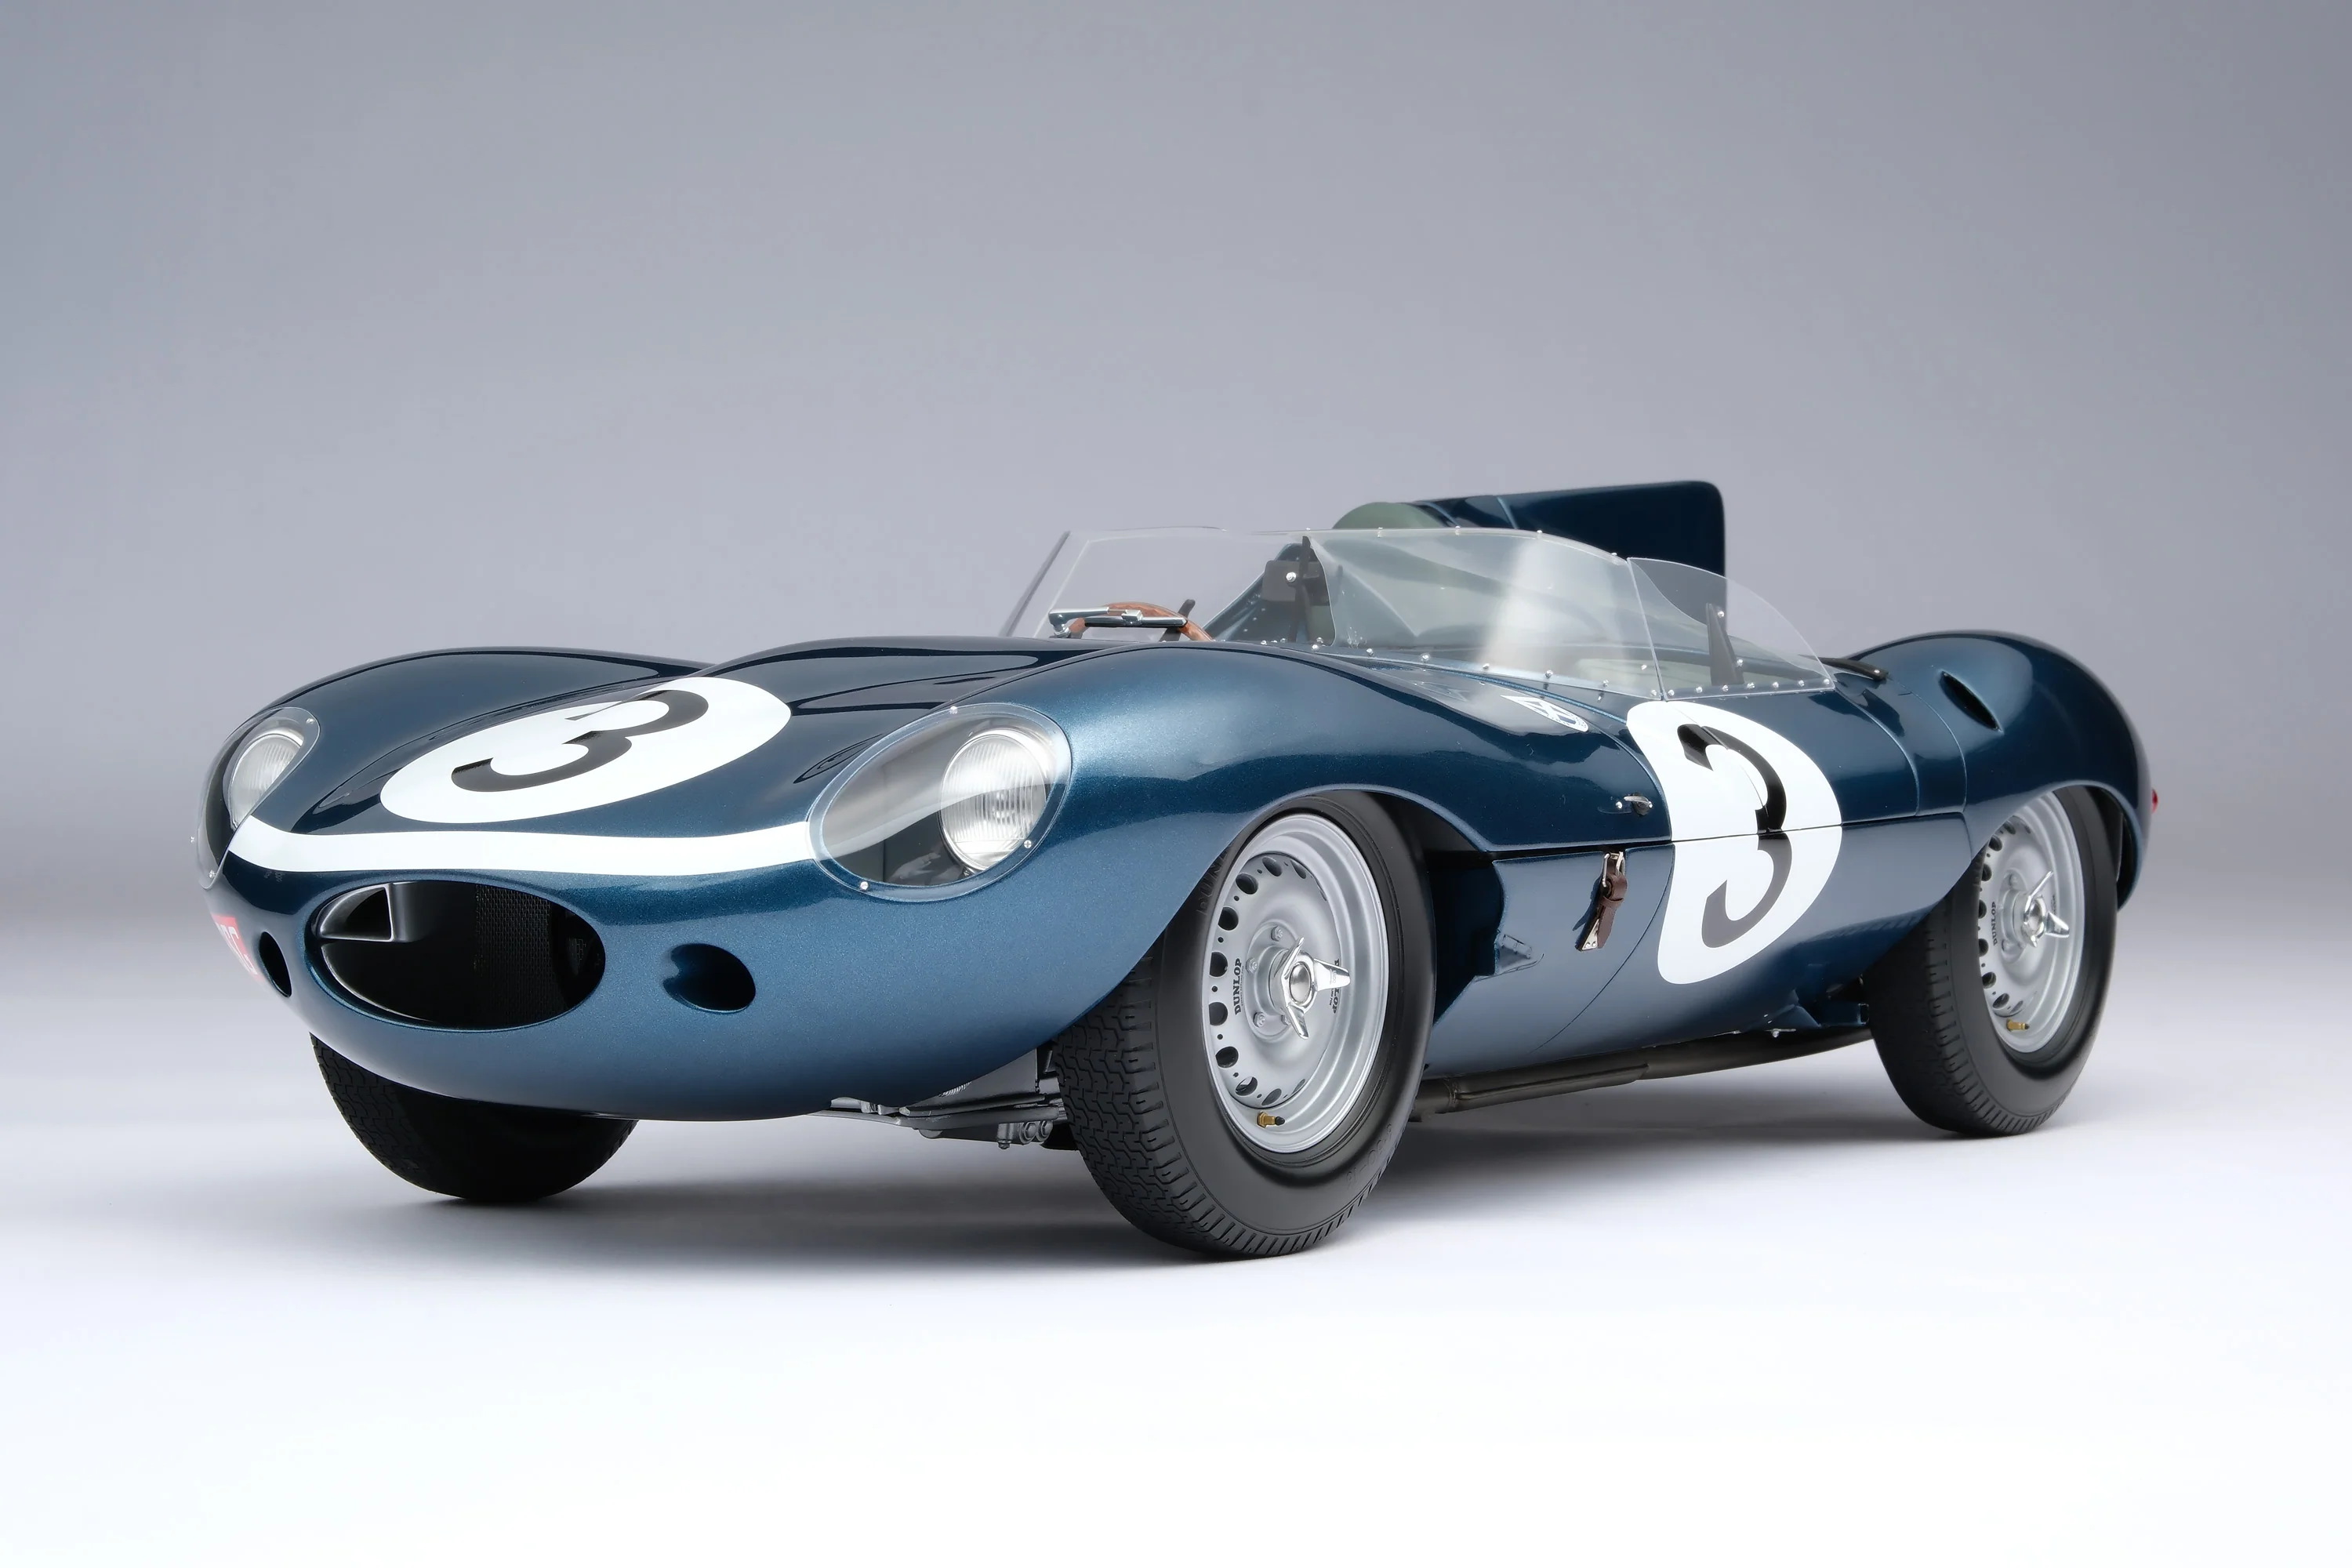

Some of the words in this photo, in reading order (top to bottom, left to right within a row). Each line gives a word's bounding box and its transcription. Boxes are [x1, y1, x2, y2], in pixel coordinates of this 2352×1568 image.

[452, 689, 709, 792] 3
[1677, 724, 1792, 948] 3
[1232, 958, 1243, 1015] DUNLOP
